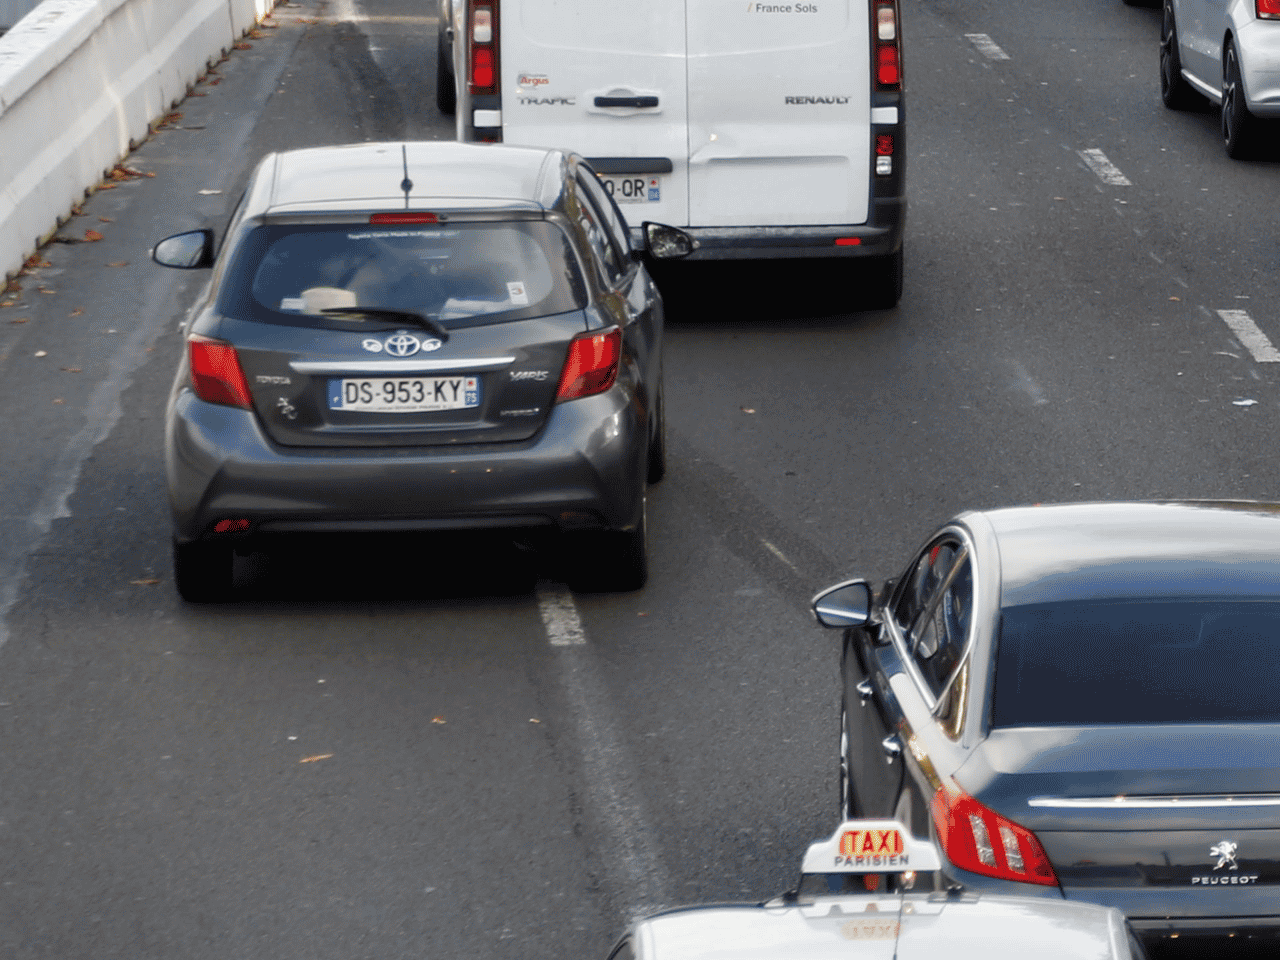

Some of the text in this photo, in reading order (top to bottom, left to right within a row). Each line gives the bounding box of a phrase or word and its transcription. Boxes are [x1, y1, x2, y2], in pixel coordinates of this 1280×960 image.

[755, 2, 818, 13] France Sols
[520, 76, 549, 86] Argus
[516, 96, 576, 106] TRAFIC
[785, 96, 852, 105] RENAULT
[510, 371, 549, 381] YARIS
[345, 380, 462, 404] DS-953-KY
[847, 830, 899, 853] TAXI
[834, 854, 909, 867] PARISIEN
[1191, 875, 1259, 885] PEUGEOT
